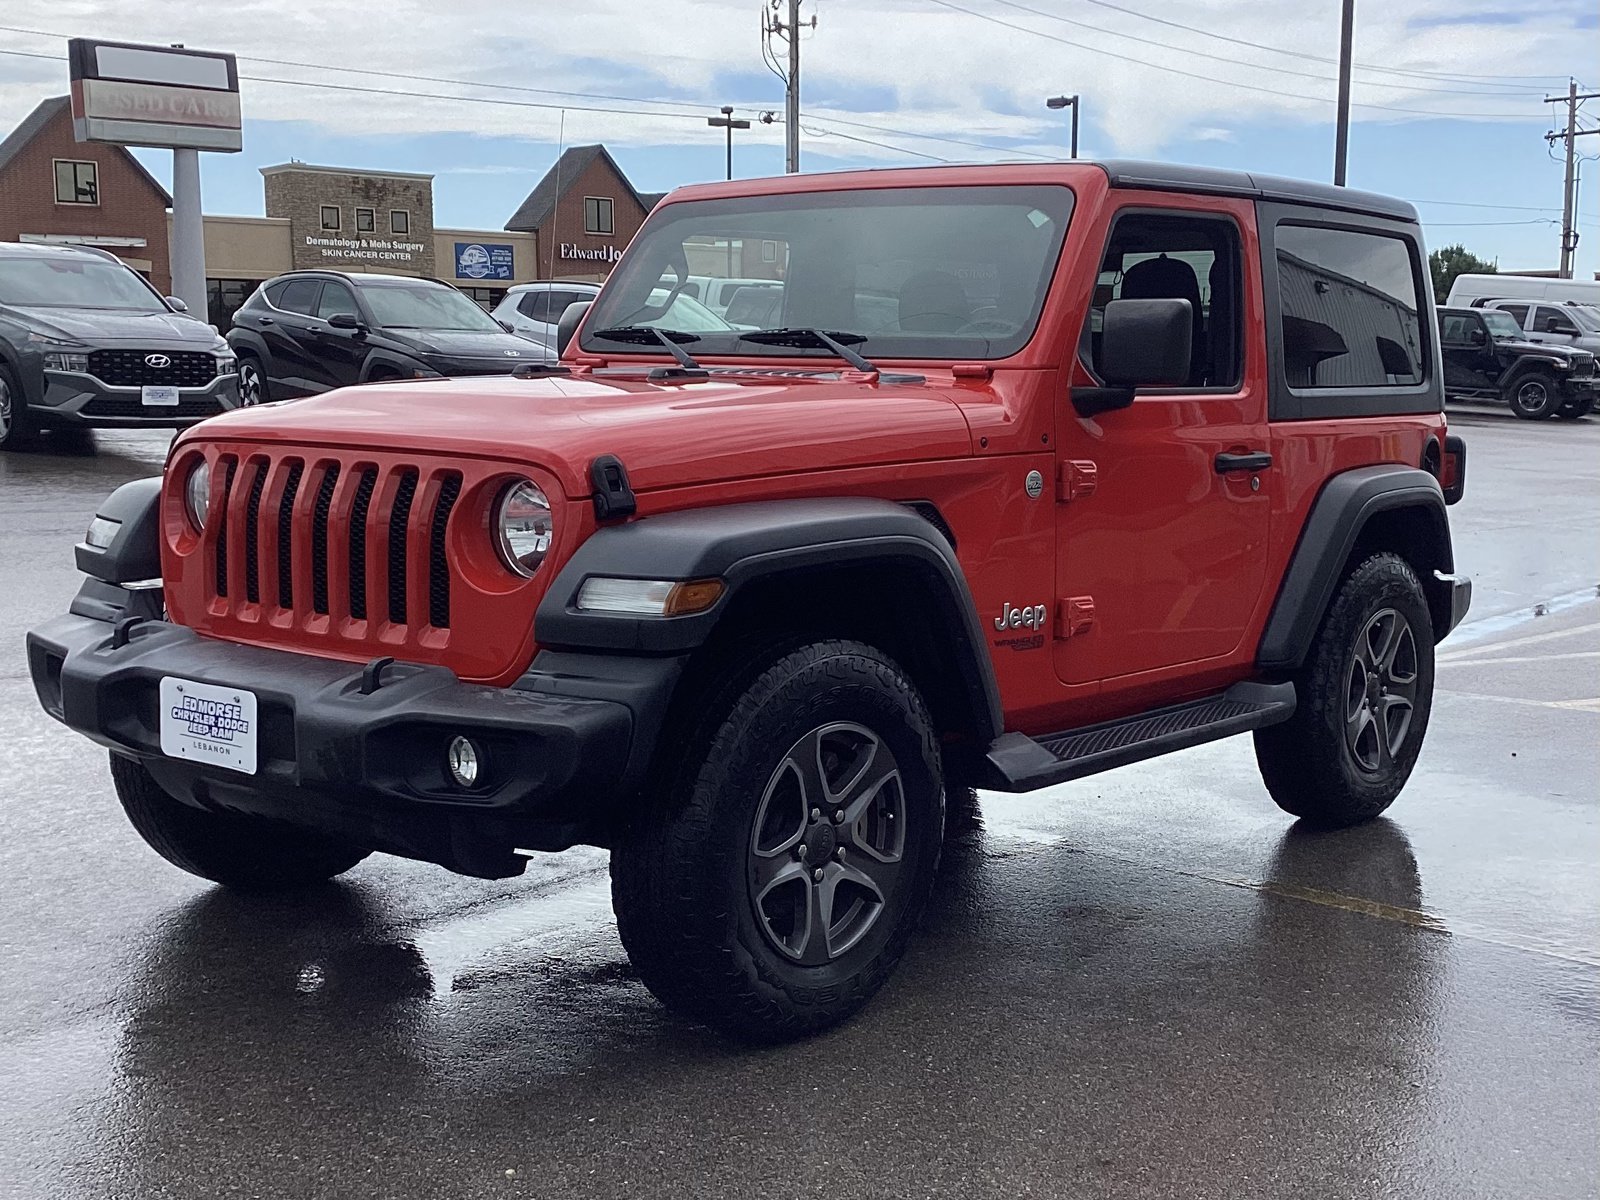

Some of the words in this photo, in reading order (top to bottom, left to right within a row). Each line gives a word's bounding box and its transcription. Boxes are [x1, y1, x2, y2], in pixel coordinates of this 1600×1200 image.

[306, 237, 360, 249] Dermatology
[361, 239, 368, 248] &
[370, 240, 391, 249] Mohs
[393, 241, 424, 252] Surgery
[560, 243, 606, 260] Edward
[608, 246, 623, 262] Jo
[321, 249, 342, 257] SKIN
[344, 250, 378, 259] CANCER
[379, 252, 411, 260] CENTER
[994, 602, 1047, 631] Jeep
[183, 696, 198, 711] ED
[198, 699, 241, 718] MORSE
[193, 741, 231, 755] LEBANON
